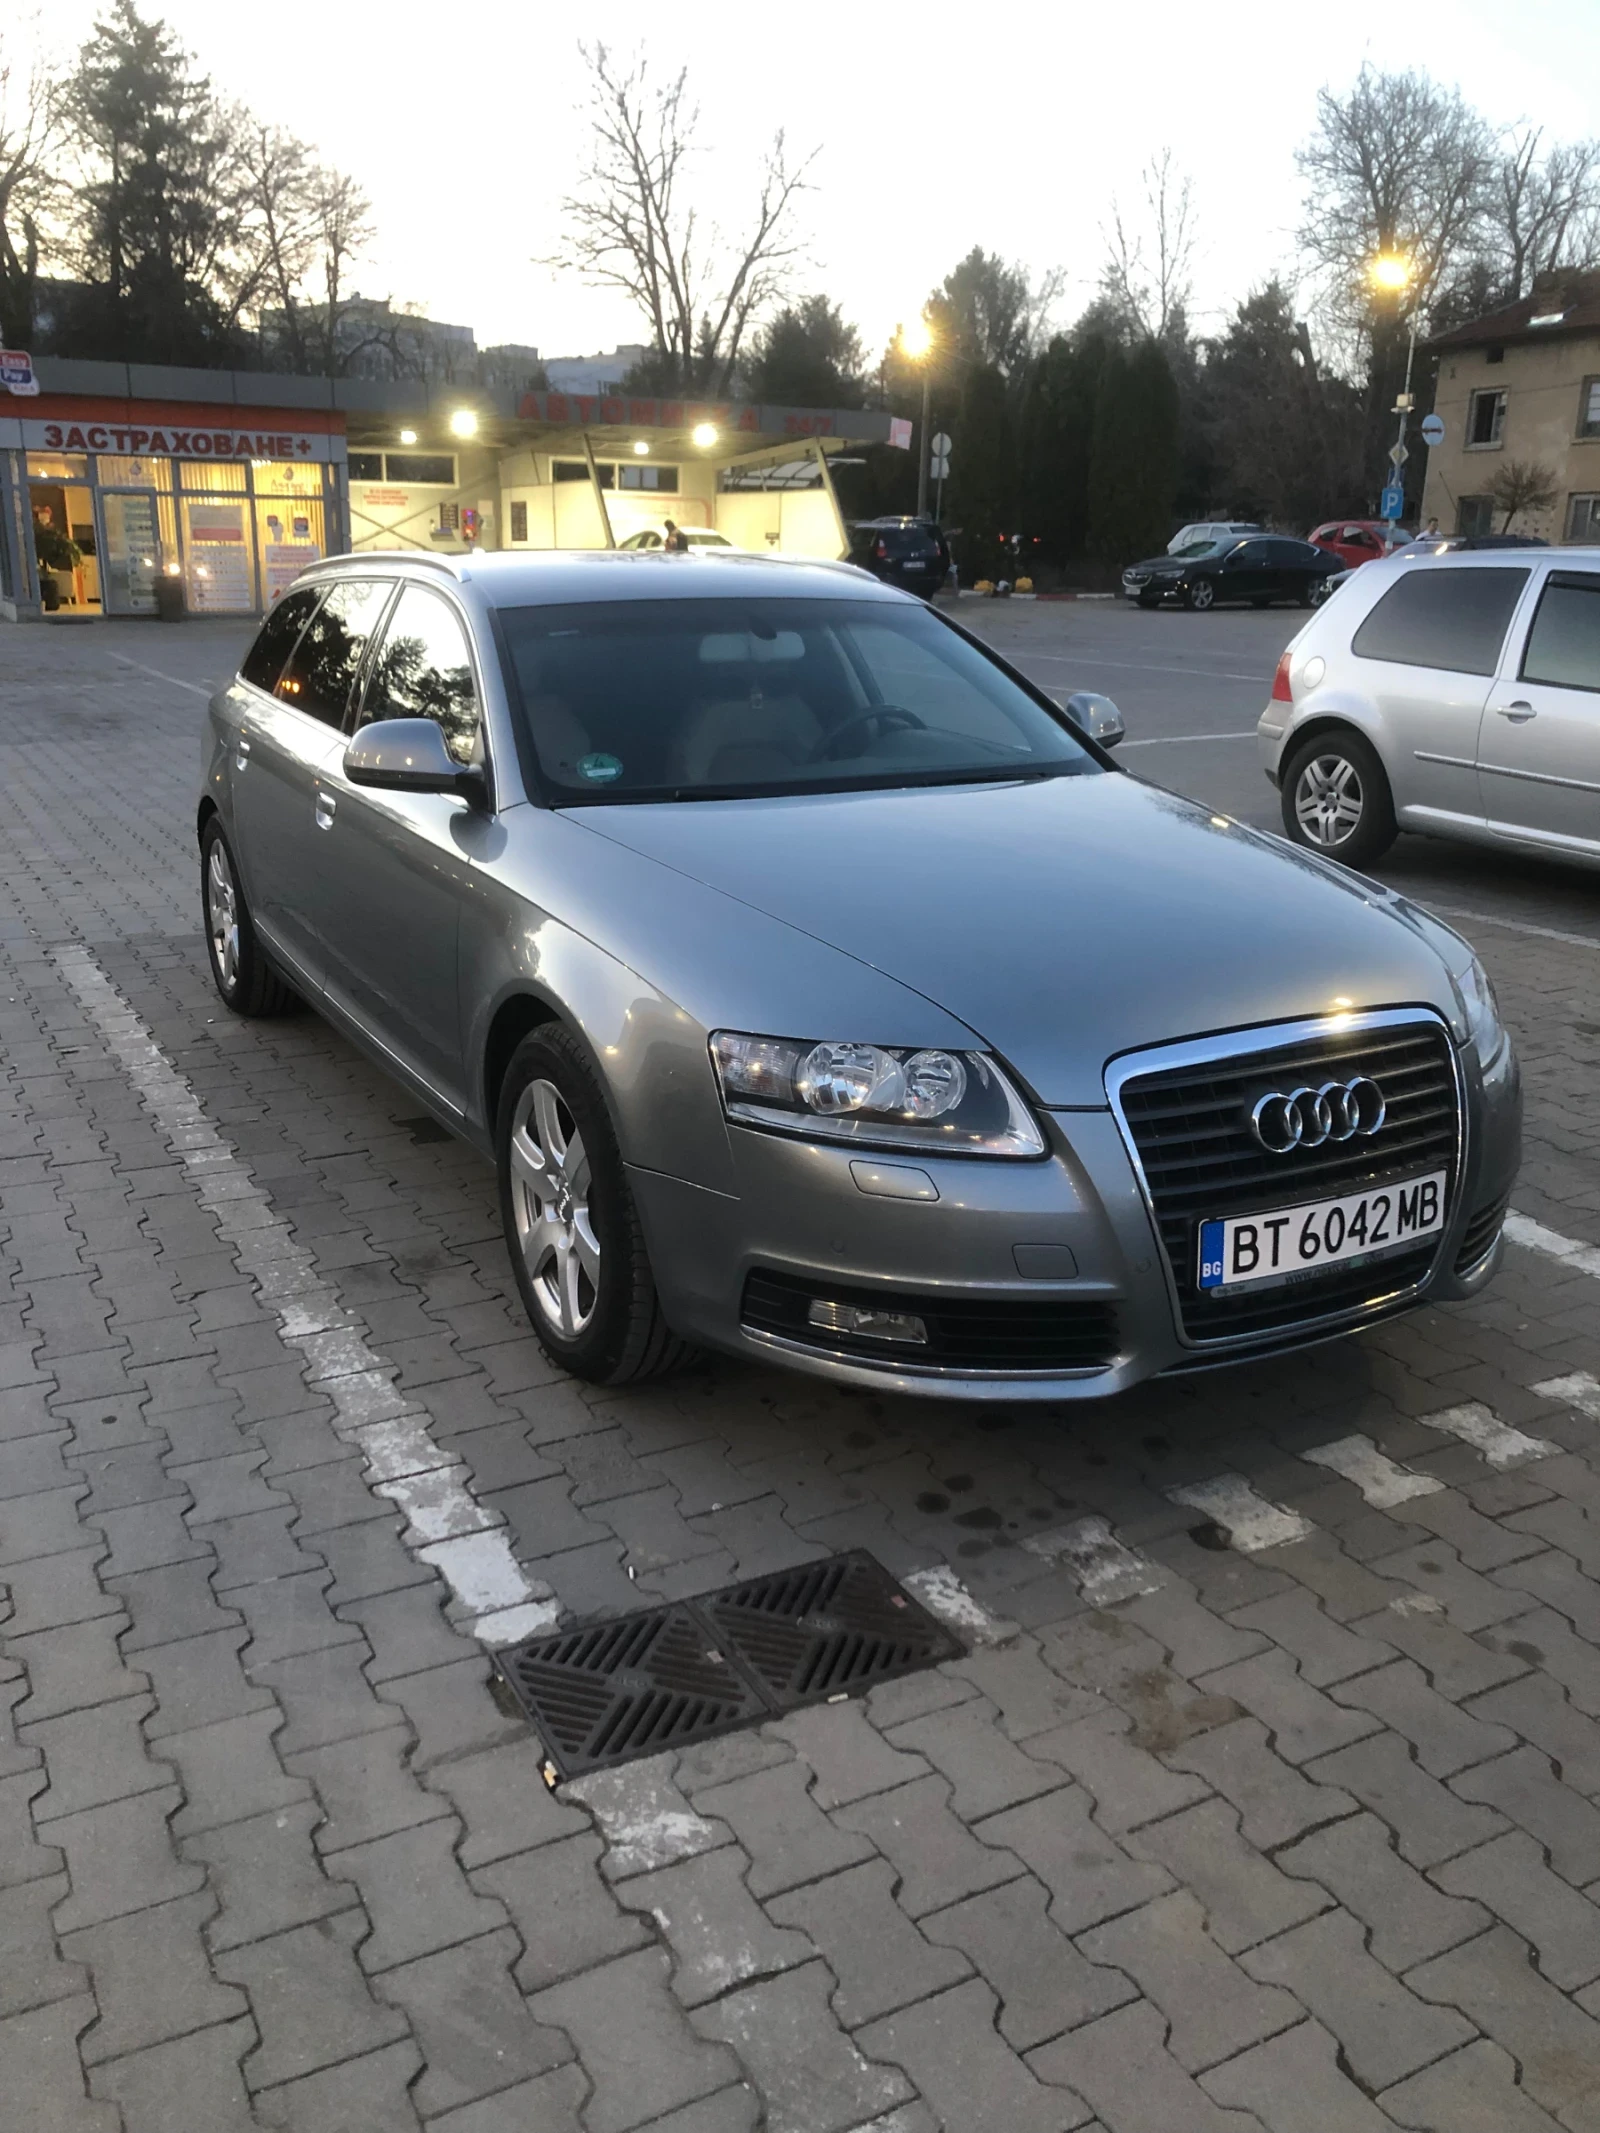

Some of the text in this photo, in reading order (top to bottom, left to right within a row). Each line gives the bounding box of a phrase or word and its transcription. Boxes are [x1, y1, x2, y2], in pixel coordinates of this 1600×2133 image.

[1231, 1217, 1290, 1275] BT
[1298, 1195, 1391, 1259] 6042
[1397, 1180, 1439, 1237] MB
[1202, 1261, 1222, 1278] BG
